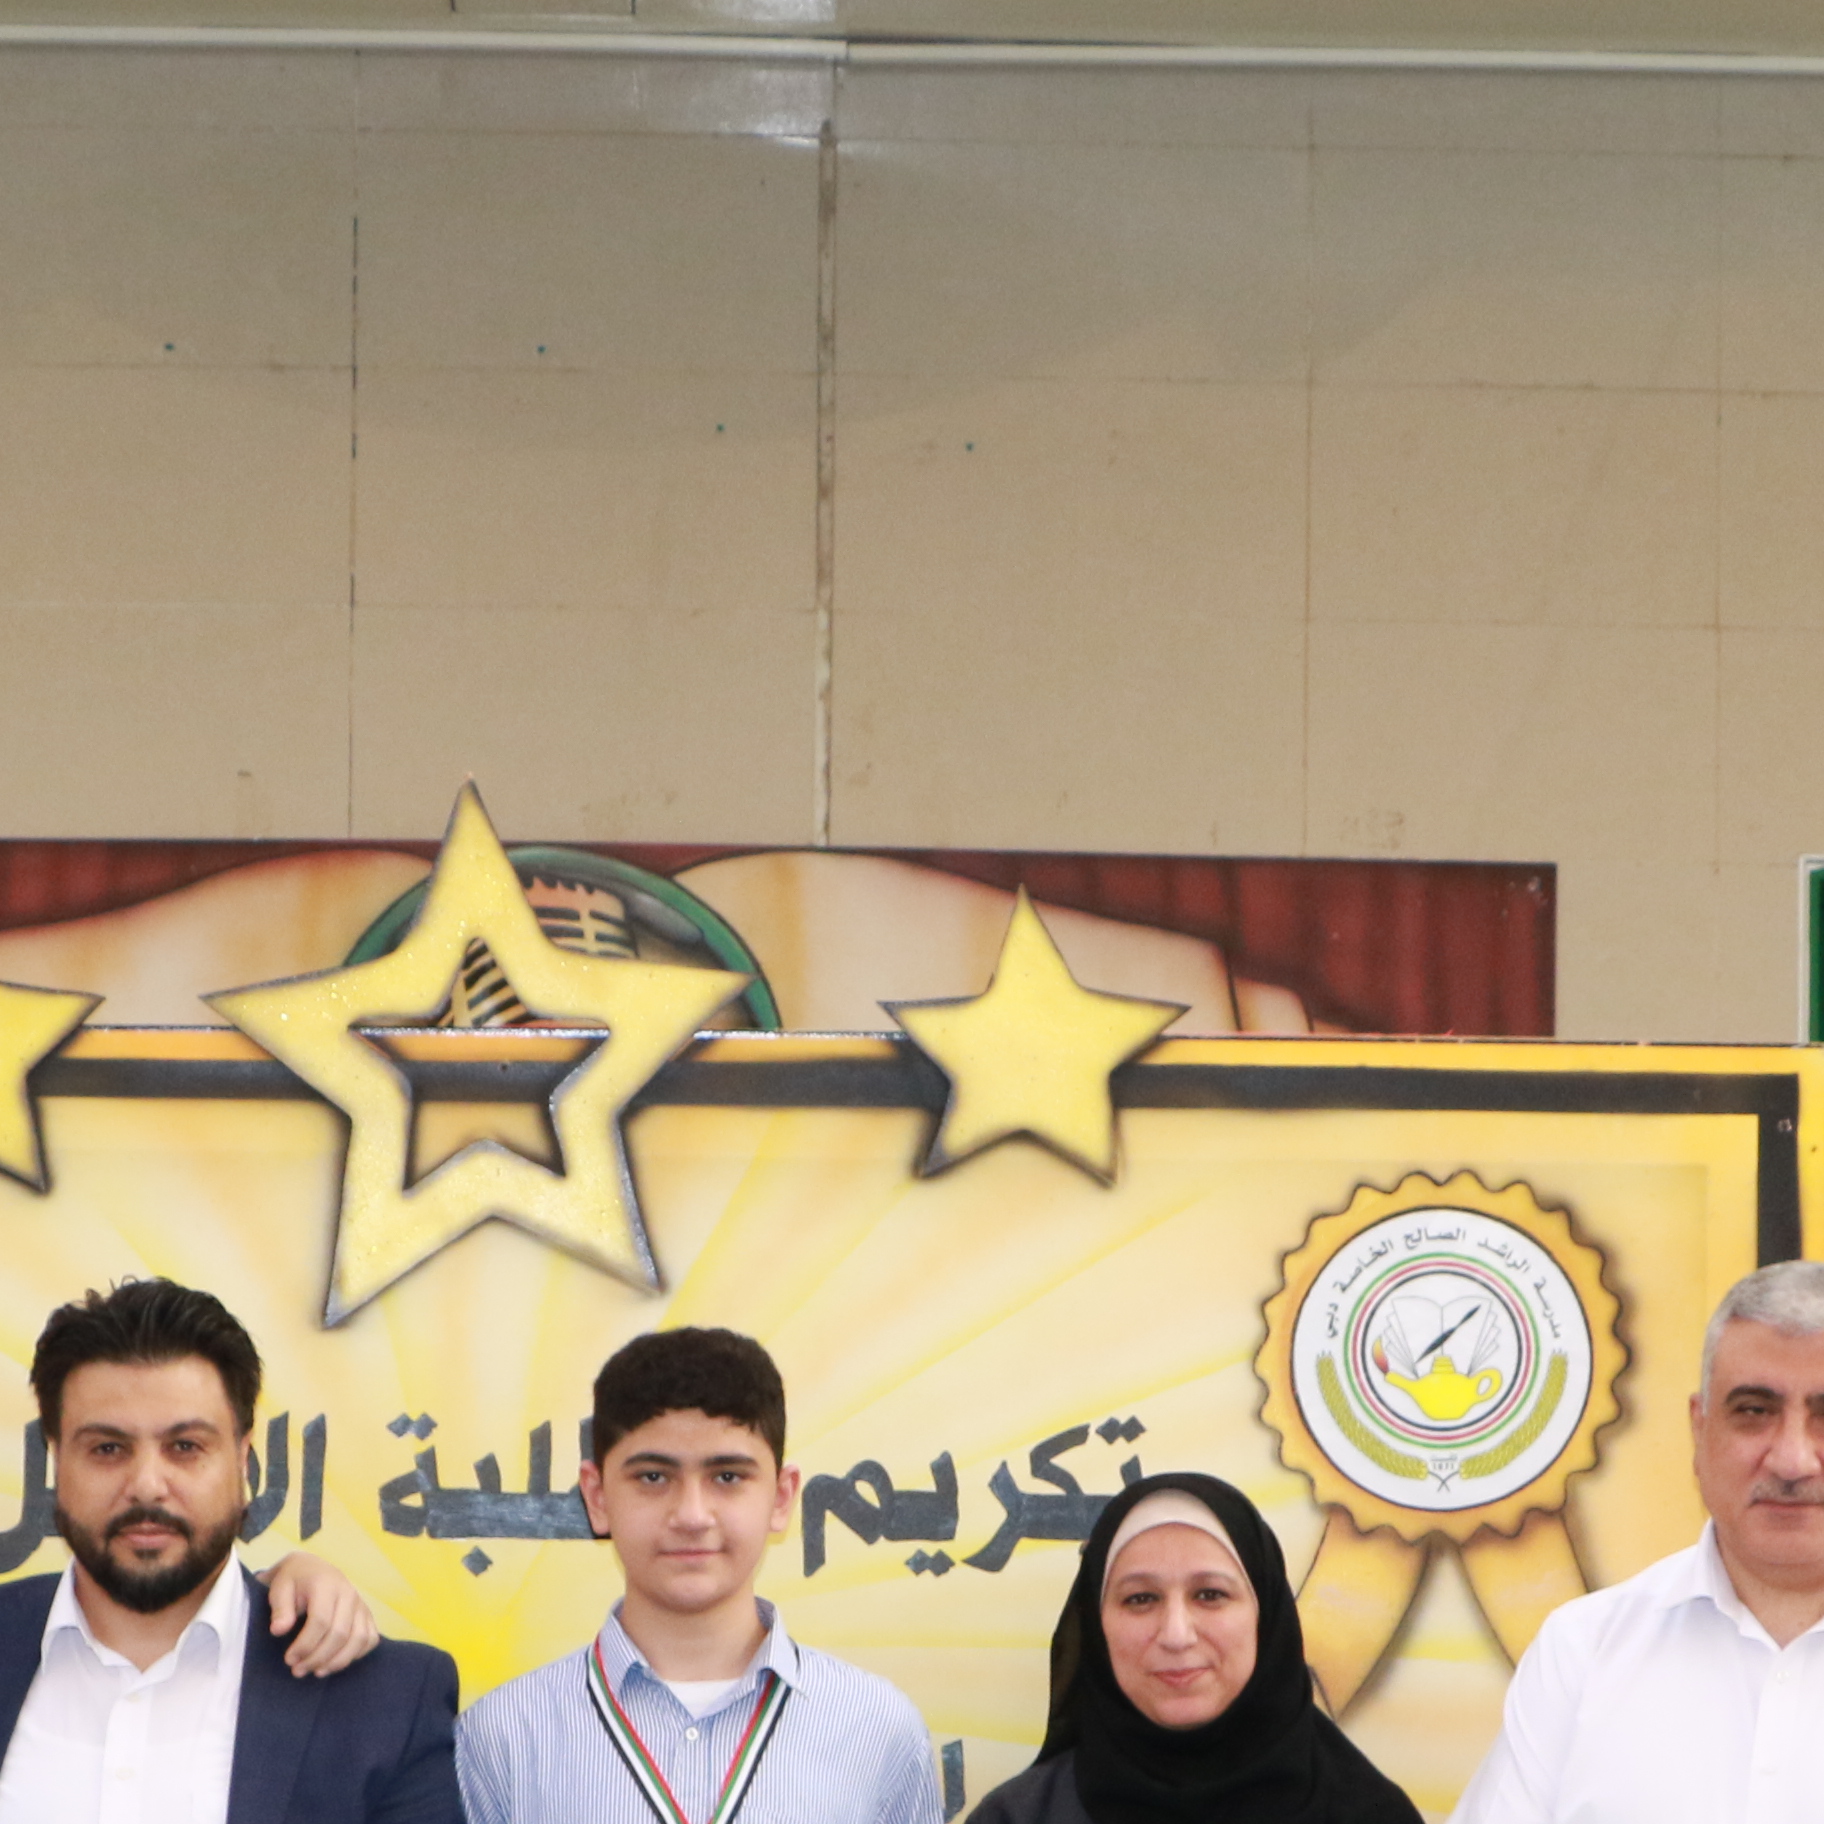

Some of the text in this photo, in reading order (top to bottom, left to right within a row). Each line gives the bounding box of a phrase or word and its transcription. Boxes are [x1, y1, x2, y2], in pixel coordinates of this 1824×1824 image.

[1326, 1227, 1561, 1339] مدرسة الراشد الصالح الخاصة دبي
[802, 1415, 1147, 1578] تكريم
